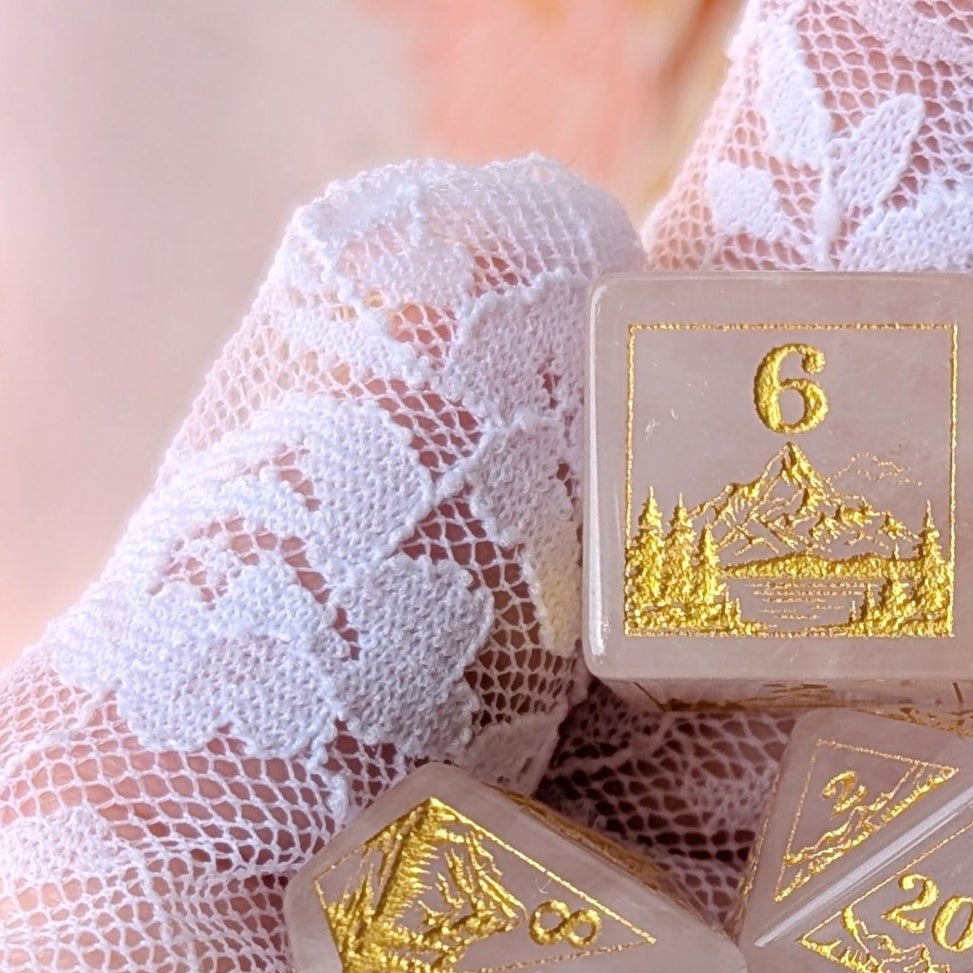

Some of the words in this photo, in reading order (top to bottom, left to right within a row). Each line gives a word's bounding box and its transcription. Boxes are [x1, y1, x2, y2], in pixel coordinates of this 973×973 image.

[753, 342, 830, 435] 6
[821, 770, 866, 816] 2
[532, 899, 603, 949] 8
